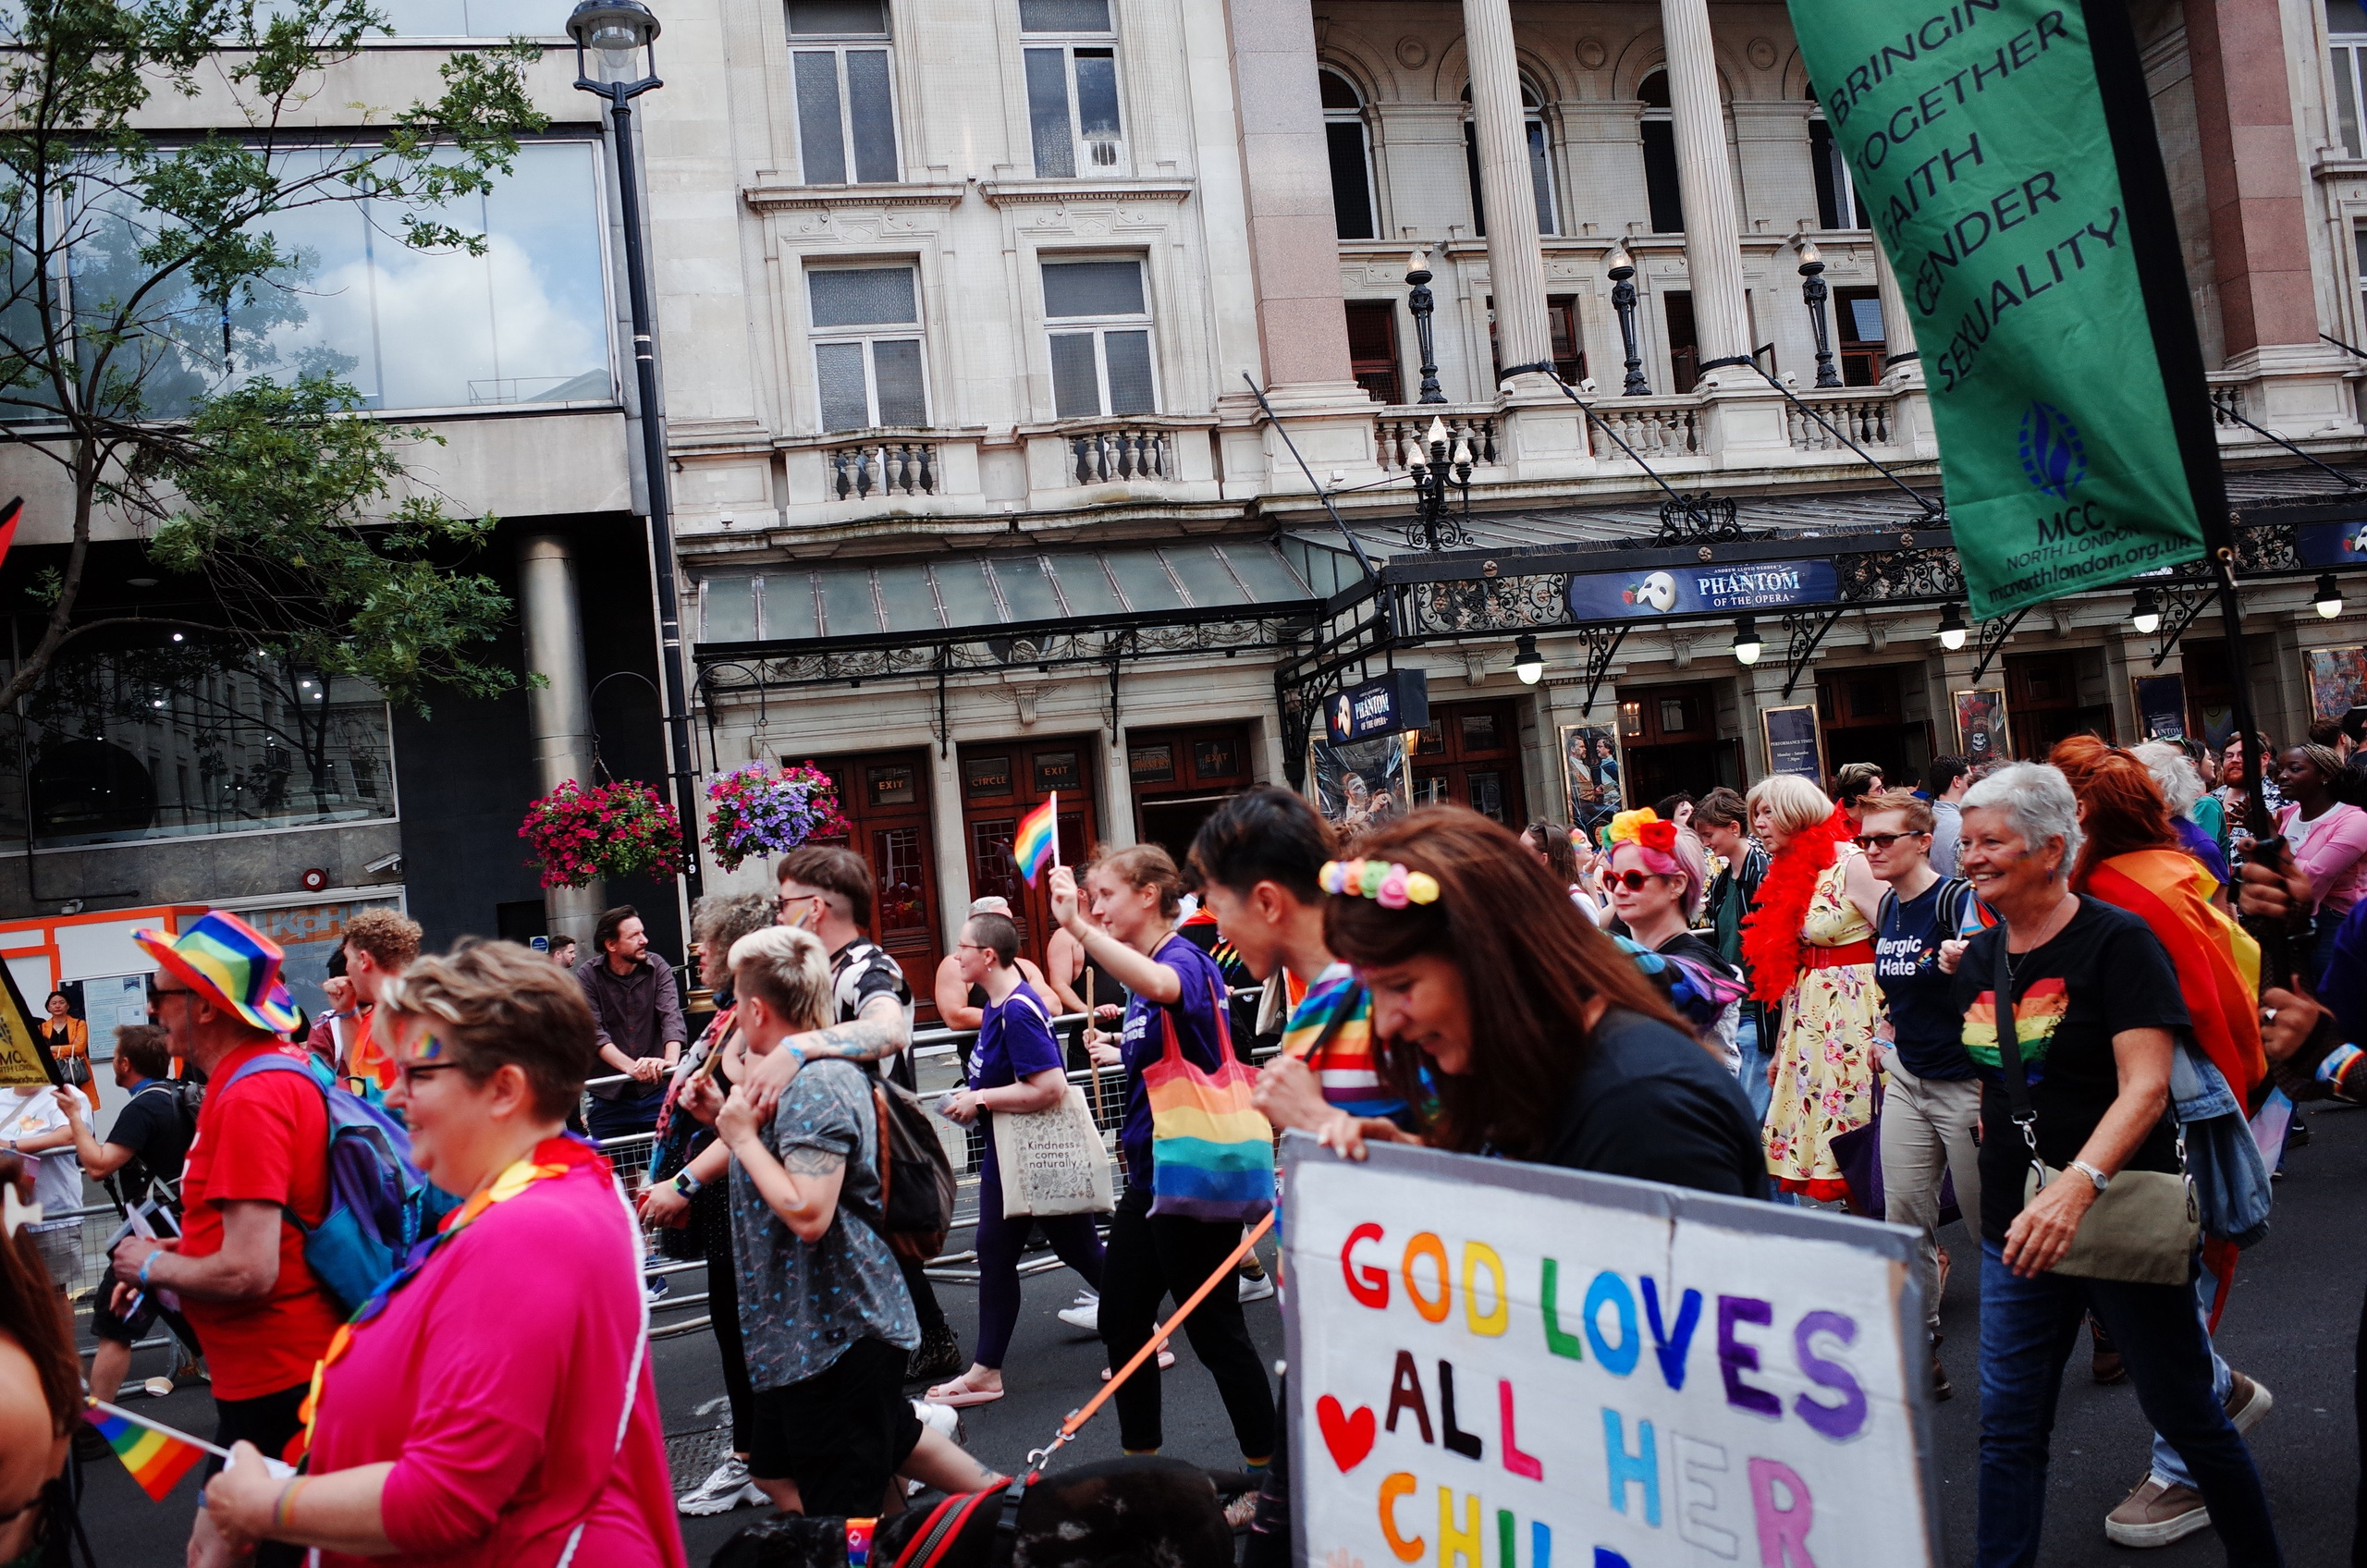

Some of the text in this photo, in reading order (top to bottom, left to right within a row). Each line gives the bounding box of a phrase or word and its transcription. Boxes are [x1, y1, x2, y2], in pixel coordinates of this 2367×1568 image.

[1857, 9, 2068, 185] TOGETHER
[1882, 132, 1984, 251] FAITH
[1915, 171, 2062, 316] GENDER
[1937, 206, 2120, 393] SEXUALITY
[2037, 501, 2105, 545] MCC
[2006, 524, 2141, 571] NORTH LONDON
[1698, 571, 1800, 595] PHANTOM
[1713, 594, 1789, 607] OF THE OPERA
[1355, 692, 1390, 720] PHANTOM
[1205, 753, 1228, 763] EXIT
[972, 776, 1007, 787] CIRCLE
[1045, 766, 1068, 776] EXIT
[878, 779, 903, 790] EXIT
[1879, 958, 1916, 976] Hate
[1028, 1140, 1074, 1151] Kindness
[1035, 1151, 1070, 1159] comes
[1029, 1158, 1076, 1170] naturally
[1342, 1222, 1869, 1441] GOD LOVES
[1386, 1350, 1815, 1568] ALL HER
